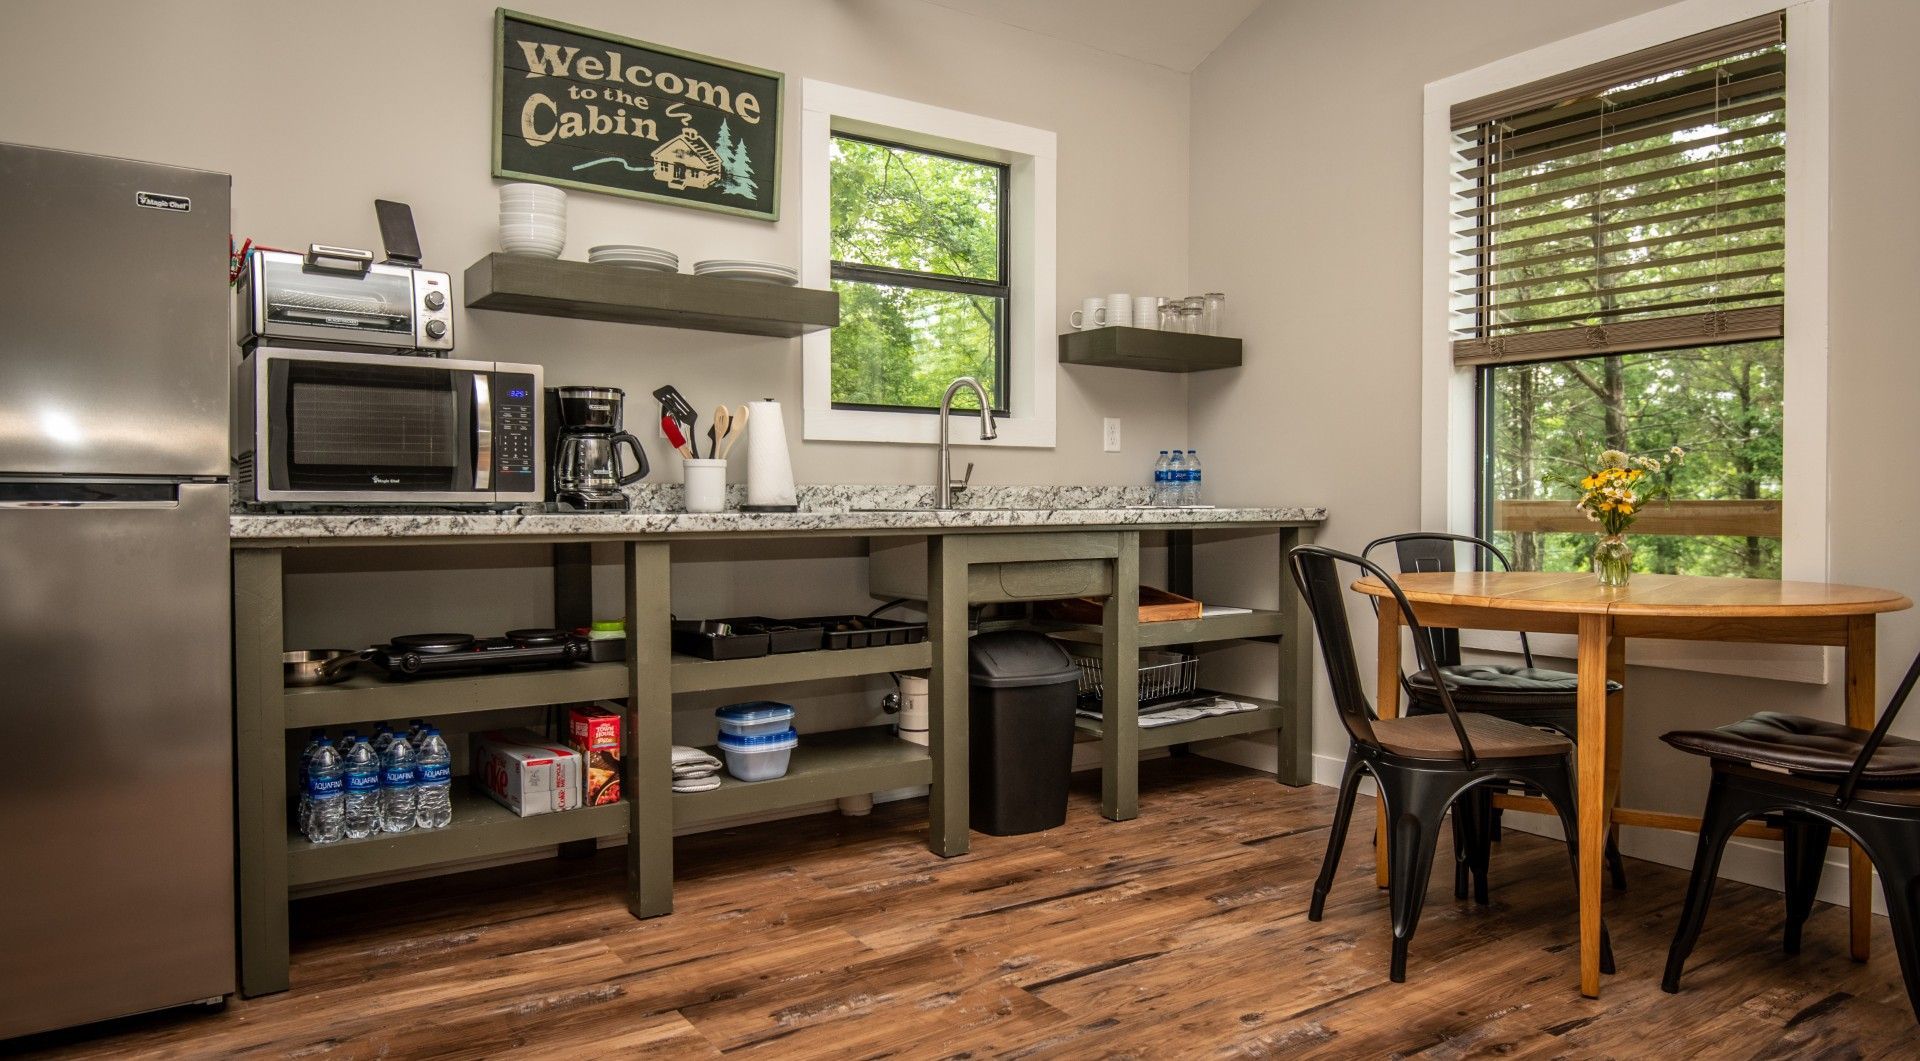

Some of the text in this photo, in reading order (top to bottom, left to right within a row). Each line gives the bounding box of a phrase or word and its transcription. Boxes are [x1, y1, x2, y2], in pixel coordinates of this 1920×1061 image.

[516, 39, 761, 125] Welcome
[568, 84, 650, 111] to the
[520, 92, 660, 148] Cabin
[146, 199, 188, 209] Magic Chef
[387, 772, 414, 781] AQUAFINA
[424, 768, 450, 778] AQUAFINA
[314, 779, 342, 791] AQUAFINA
[351, 776, 379, 785] AQUAFINA
